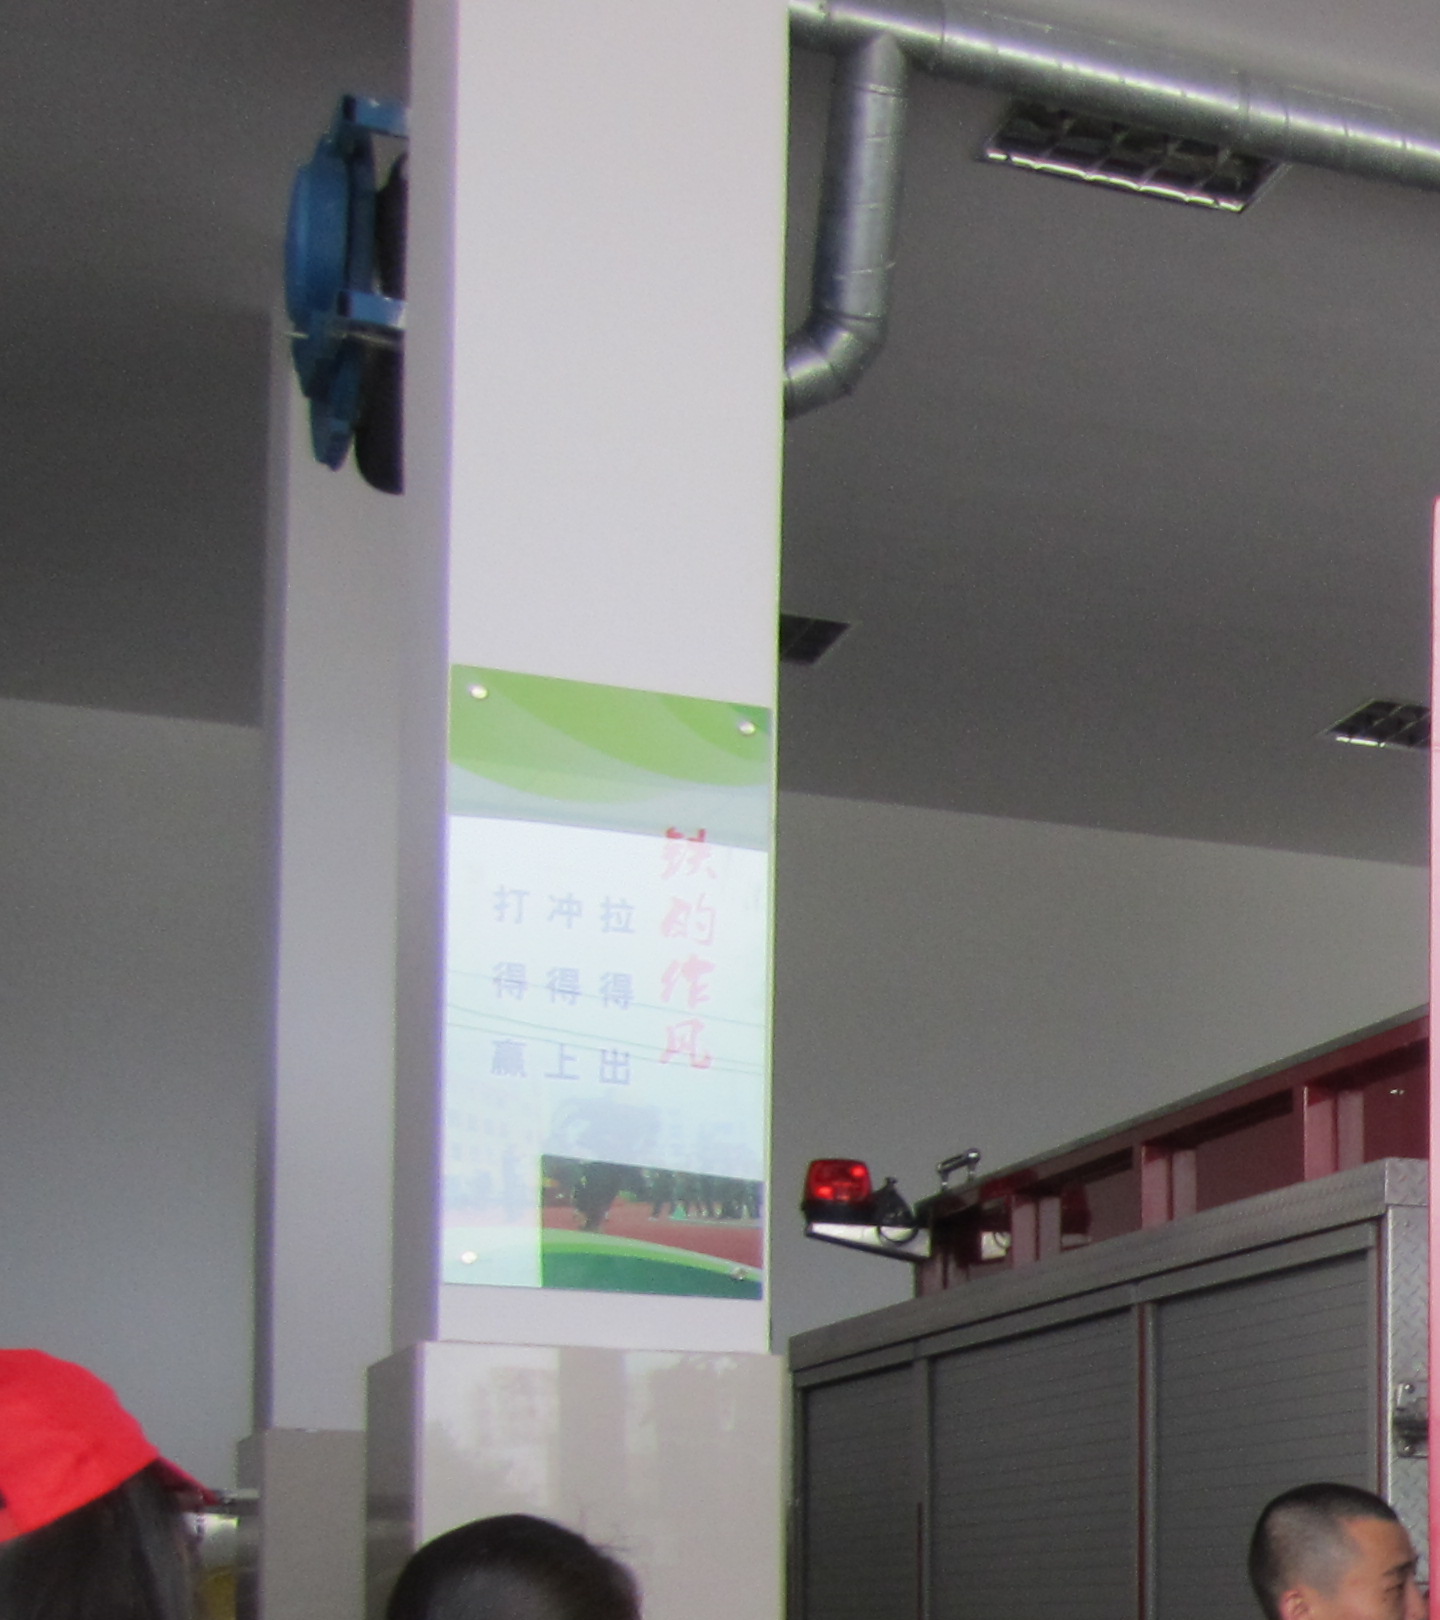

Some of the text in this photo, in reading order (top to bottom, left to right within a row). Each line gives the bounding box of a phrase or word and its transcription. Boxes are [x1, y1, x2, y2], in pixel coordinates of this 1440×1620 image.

[490, 884, 531, 1079] 打得赢
[544, 891, 584, 1082] 冲得上
[598, 897, 636, 1087] 拉得出
